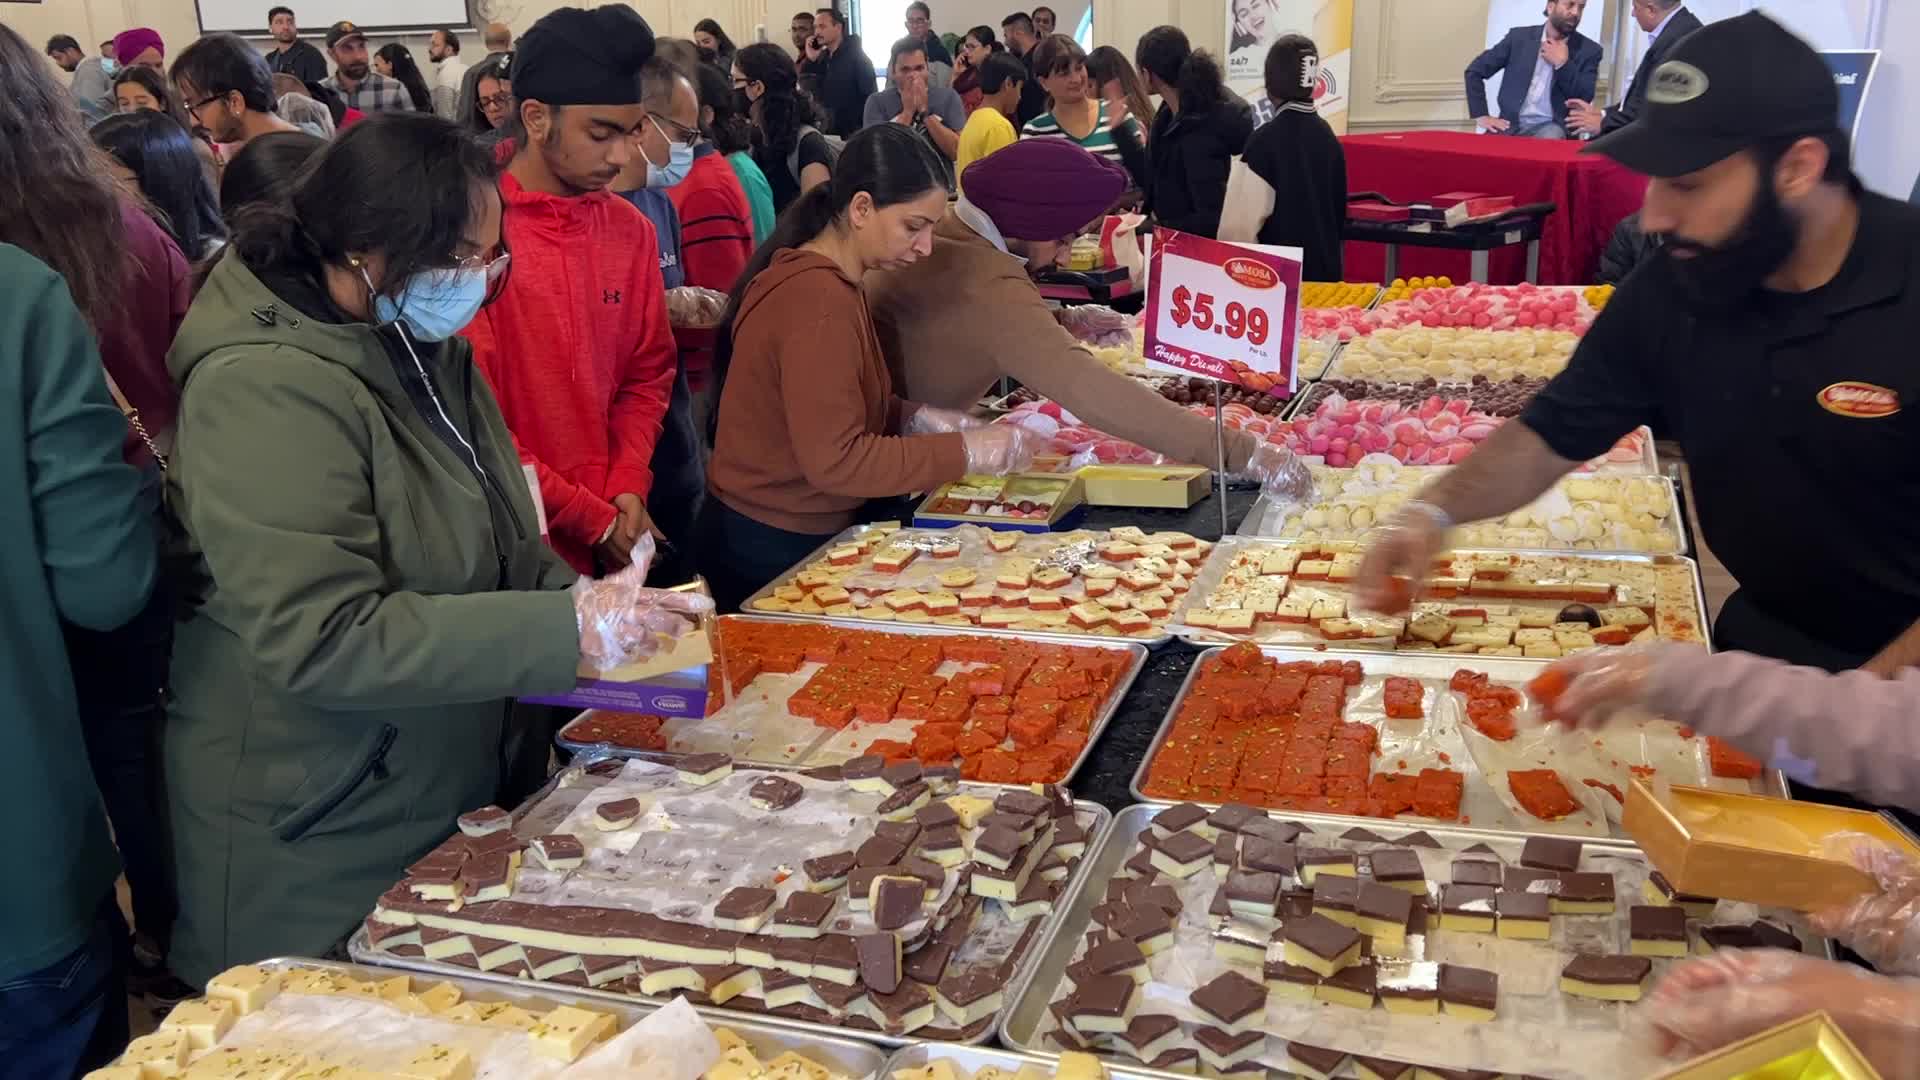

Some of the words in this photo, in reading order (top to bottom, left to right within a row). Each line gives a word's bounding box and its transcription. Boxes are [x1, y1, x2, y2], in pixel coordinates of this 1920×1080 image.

[1231, 261, 1272, 281] SAMOSA
[1170, 284, 1269, 345] $5.99
[1154, 345, 1187, 367] Happy
[1189, 354, 1225, 374] Diwali
